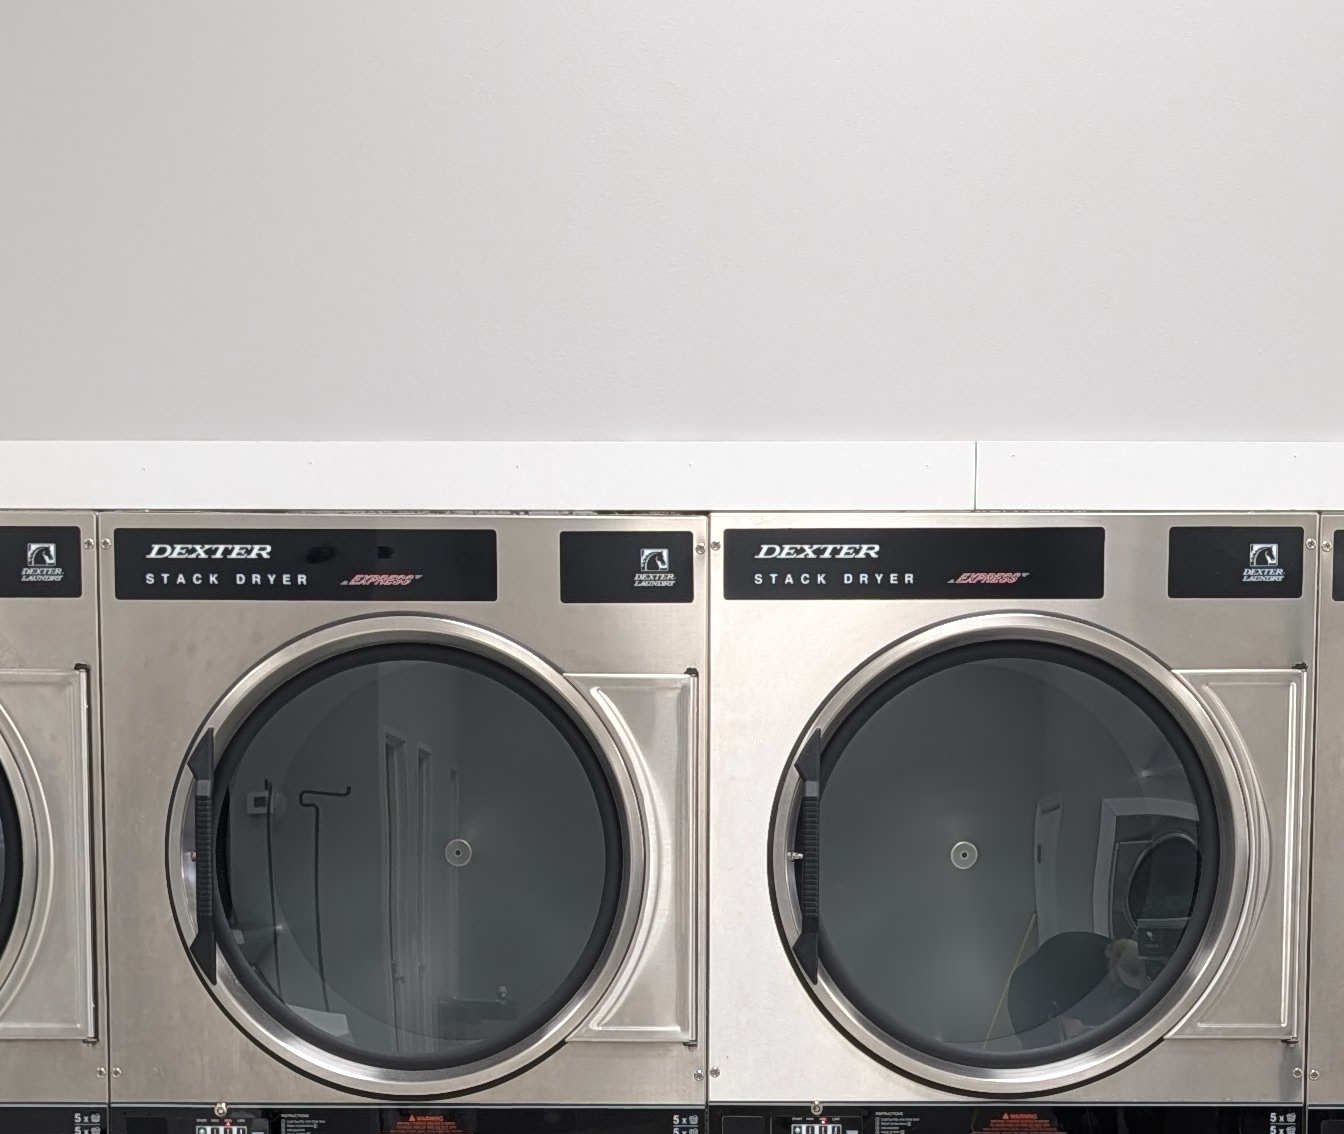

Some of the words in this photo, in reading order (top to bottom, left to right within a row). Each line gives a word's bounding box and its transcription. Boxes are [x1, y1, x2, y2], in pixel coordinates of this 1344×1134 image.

[145, 543, 272, 559] DEXTER
[754, 543, 880, 559] DEXTER
[955, 572, 1021, 584] EXPRESS
[1243, 568, 1284, 576] DEXTER
[145, 572, 219, 585] STACK
[235, 573, 307, 586] DRYER
[348, 574, 415, 586] EXPRESS
[754, 573, 827, 585] STACK
[843, 573, 914, 585] DRYER
[74, 1113, 82, 1123] 5
[83, 1115, 89, 1123] x
[672, 1114, 680, 1125] 5
[681, 1117, 688, 1125] x
[1269, 1112, 1277, 1123] 5
[1278, 1115, 1285, 1123] x
